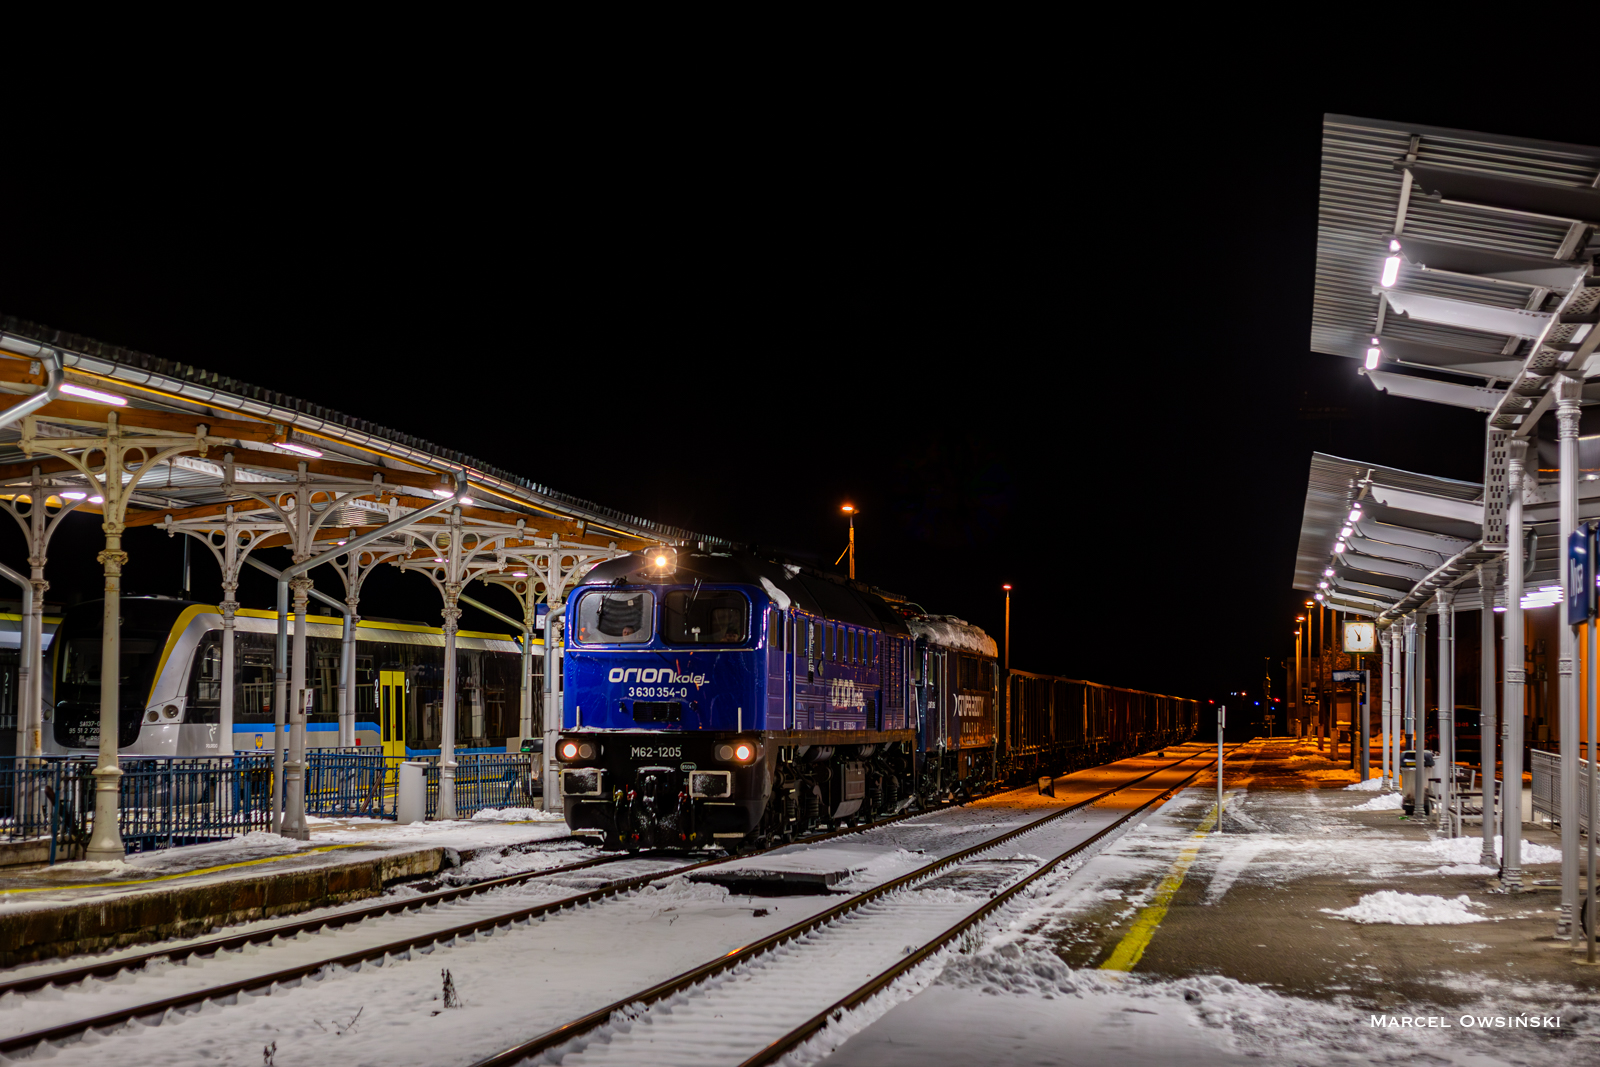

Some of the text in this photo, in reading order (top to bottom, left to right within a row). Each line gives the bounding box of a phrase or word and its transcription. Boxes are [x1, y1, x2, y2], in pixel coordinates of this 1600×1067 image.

[1570, 557, 1583, 606] Nysa
[405, 678, 410, 693] 2
[631, 747, 682, 758] M62-1205
